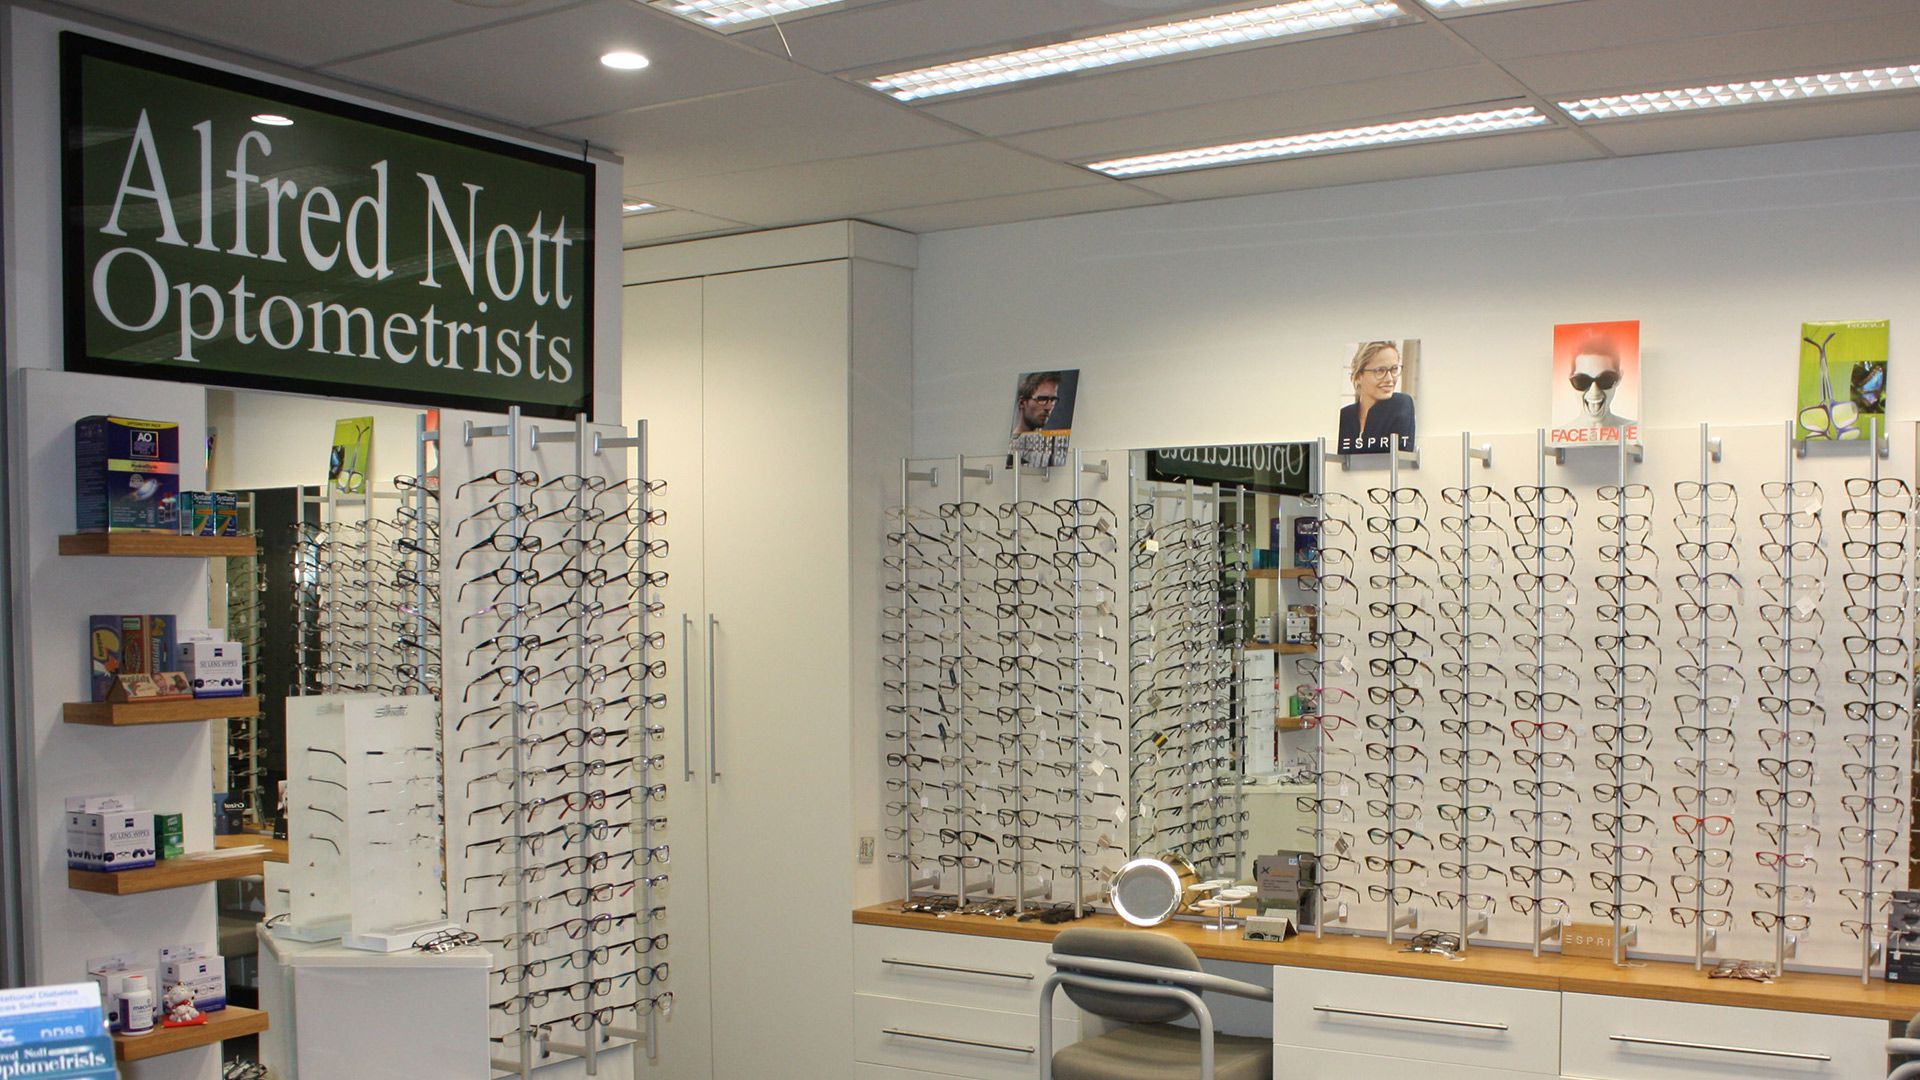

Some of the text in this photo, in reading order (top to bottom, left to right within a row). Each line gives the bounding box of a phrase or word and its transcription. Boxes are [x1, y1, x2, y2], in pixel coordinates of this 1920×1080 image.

[100, 108, 573, 310] Alfred Nott
[92, 246, 573, 384] Optometrists
[137, 432, 153, 442] AO
[1551, 428, 1588, 442] FACE
[1600, 426, 1638, 441] FAE
[1342, 435, 1409, 449] ESPRT
[1565, 934, 1611, 947] ESPRI
[0, 1050, 19, 1061] red
[0, 1051, 106, 1080] ptometrists
